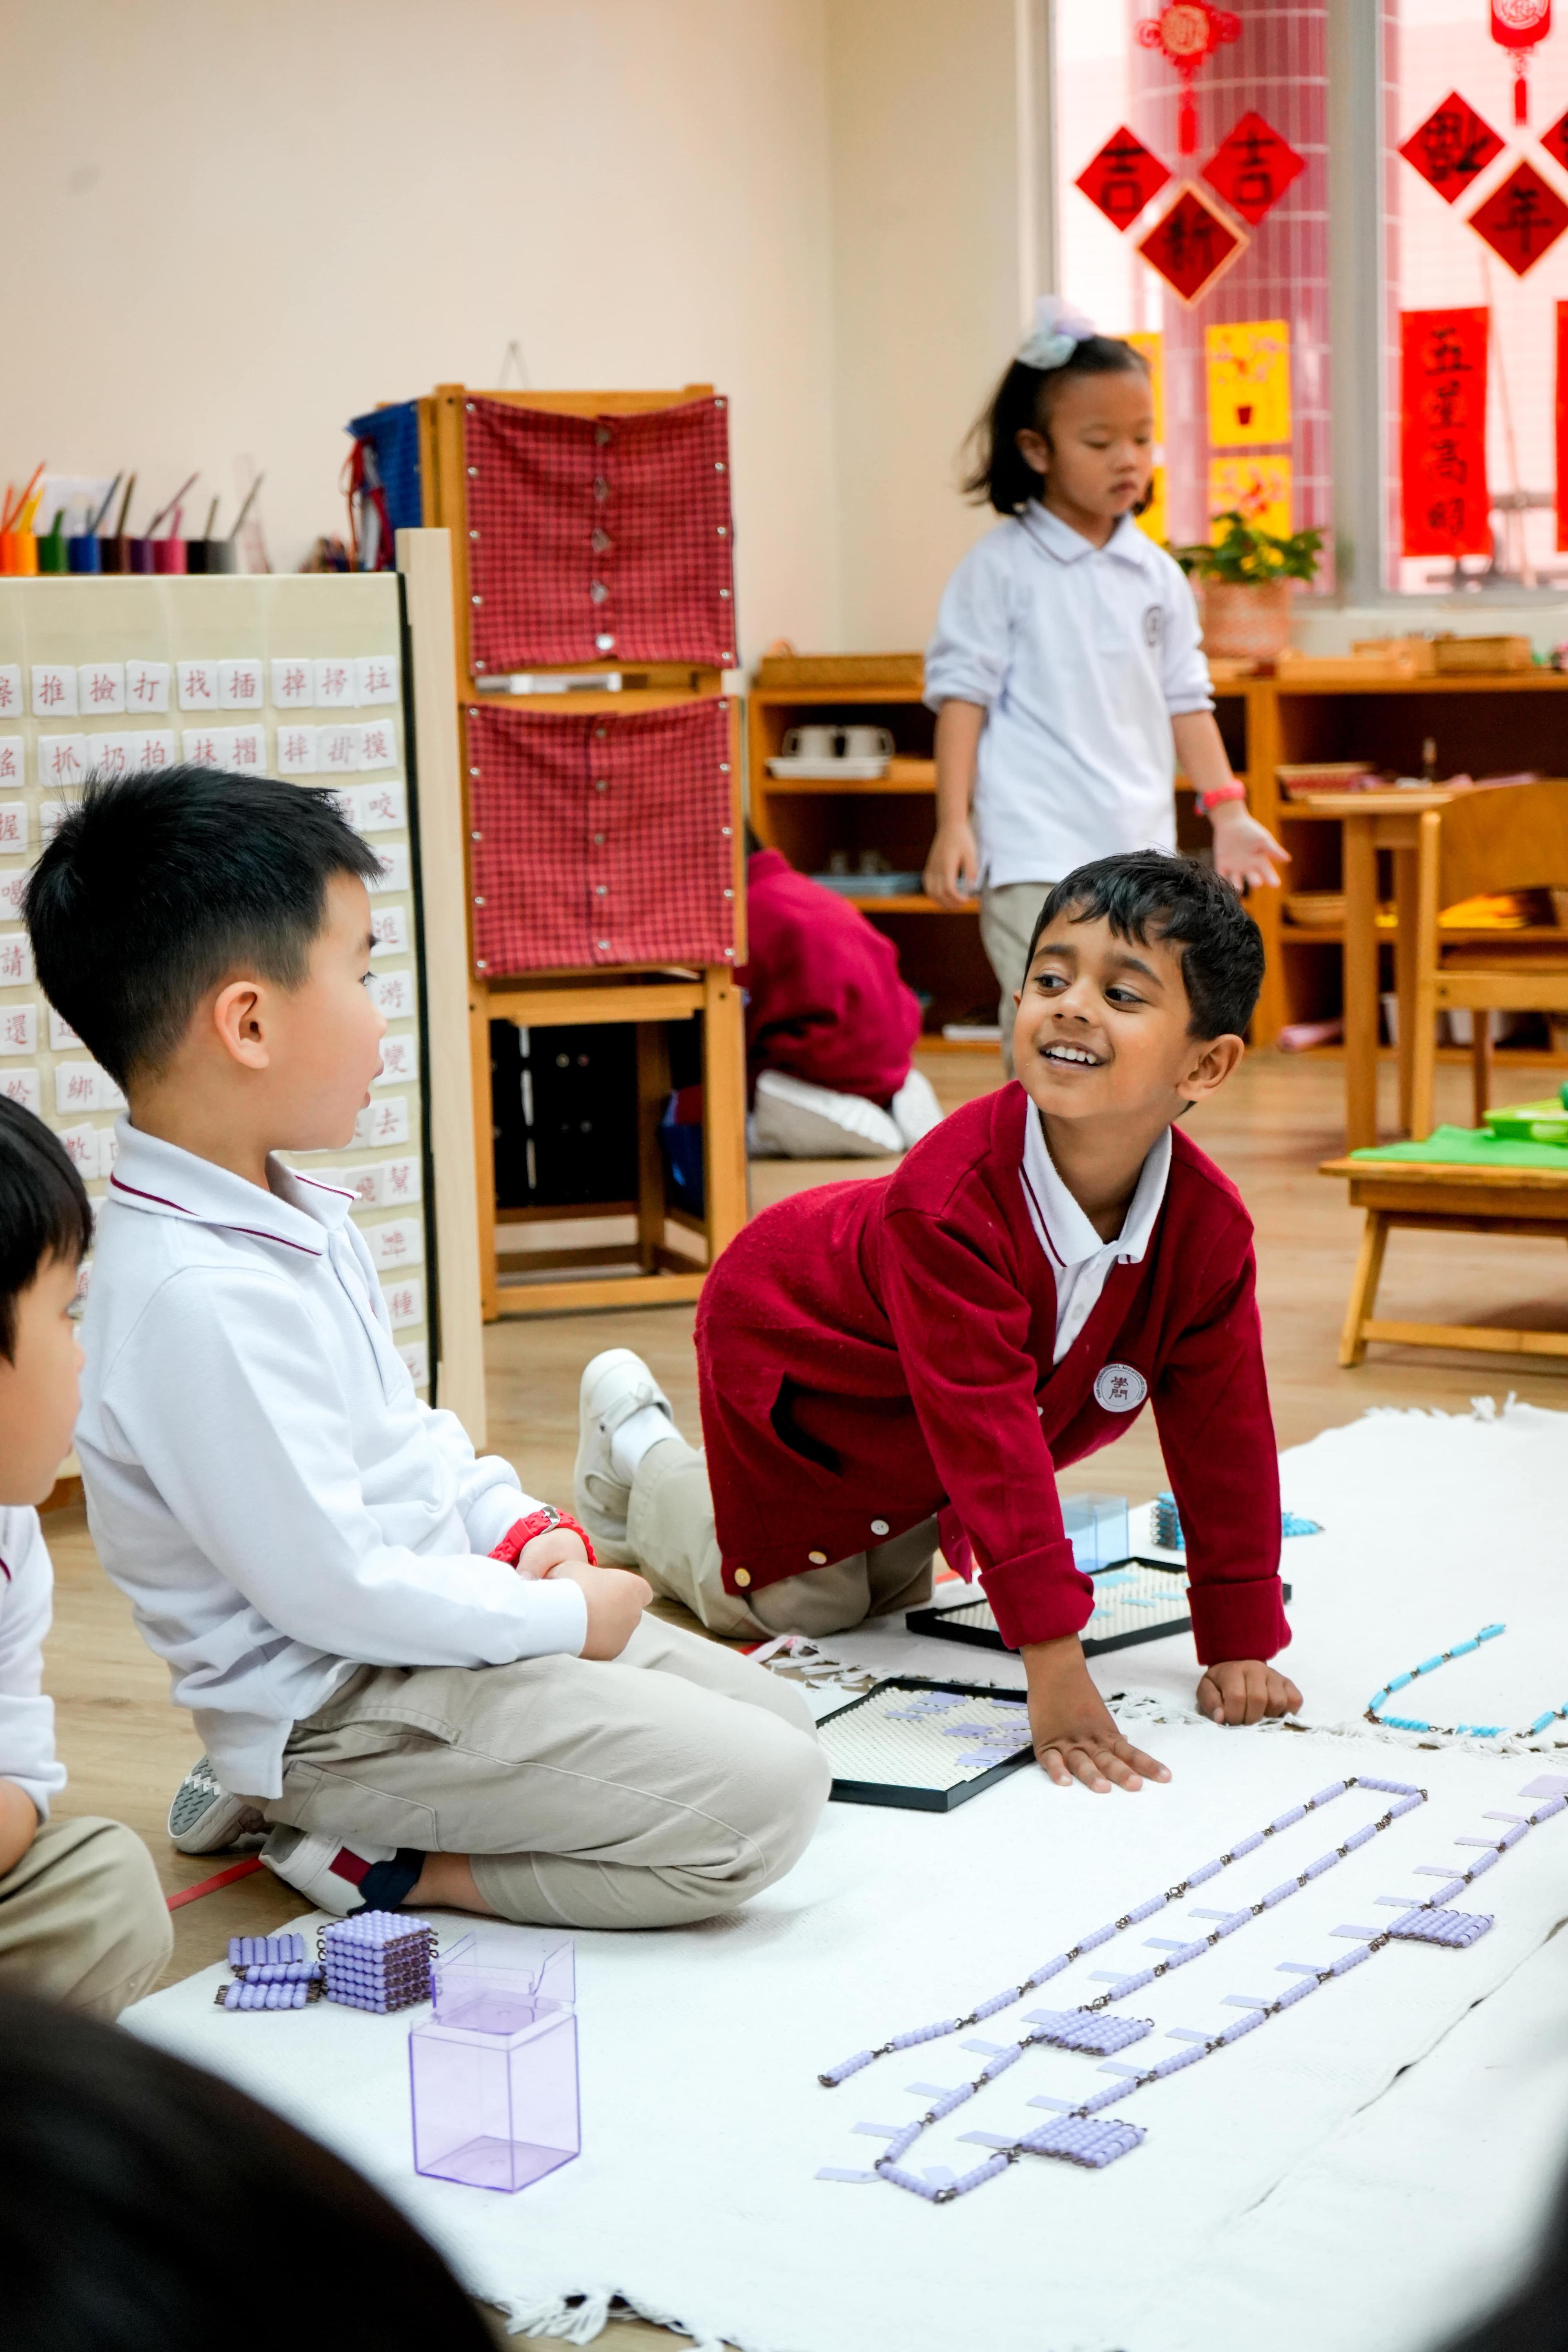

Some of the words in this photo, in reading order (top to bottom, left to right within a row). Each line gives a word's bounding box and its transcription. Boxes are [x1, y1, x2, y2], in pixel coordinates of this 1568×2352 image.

[1101, 137, 1146, 213] 吉
[1229, 129, 1276, 207] 吉
[1492, 185, 1553, 254] 年
[369, 791, 396, 819] 咬
[0, 944, 25, 977] 請
[375, 1105, 400, 1137] 去
